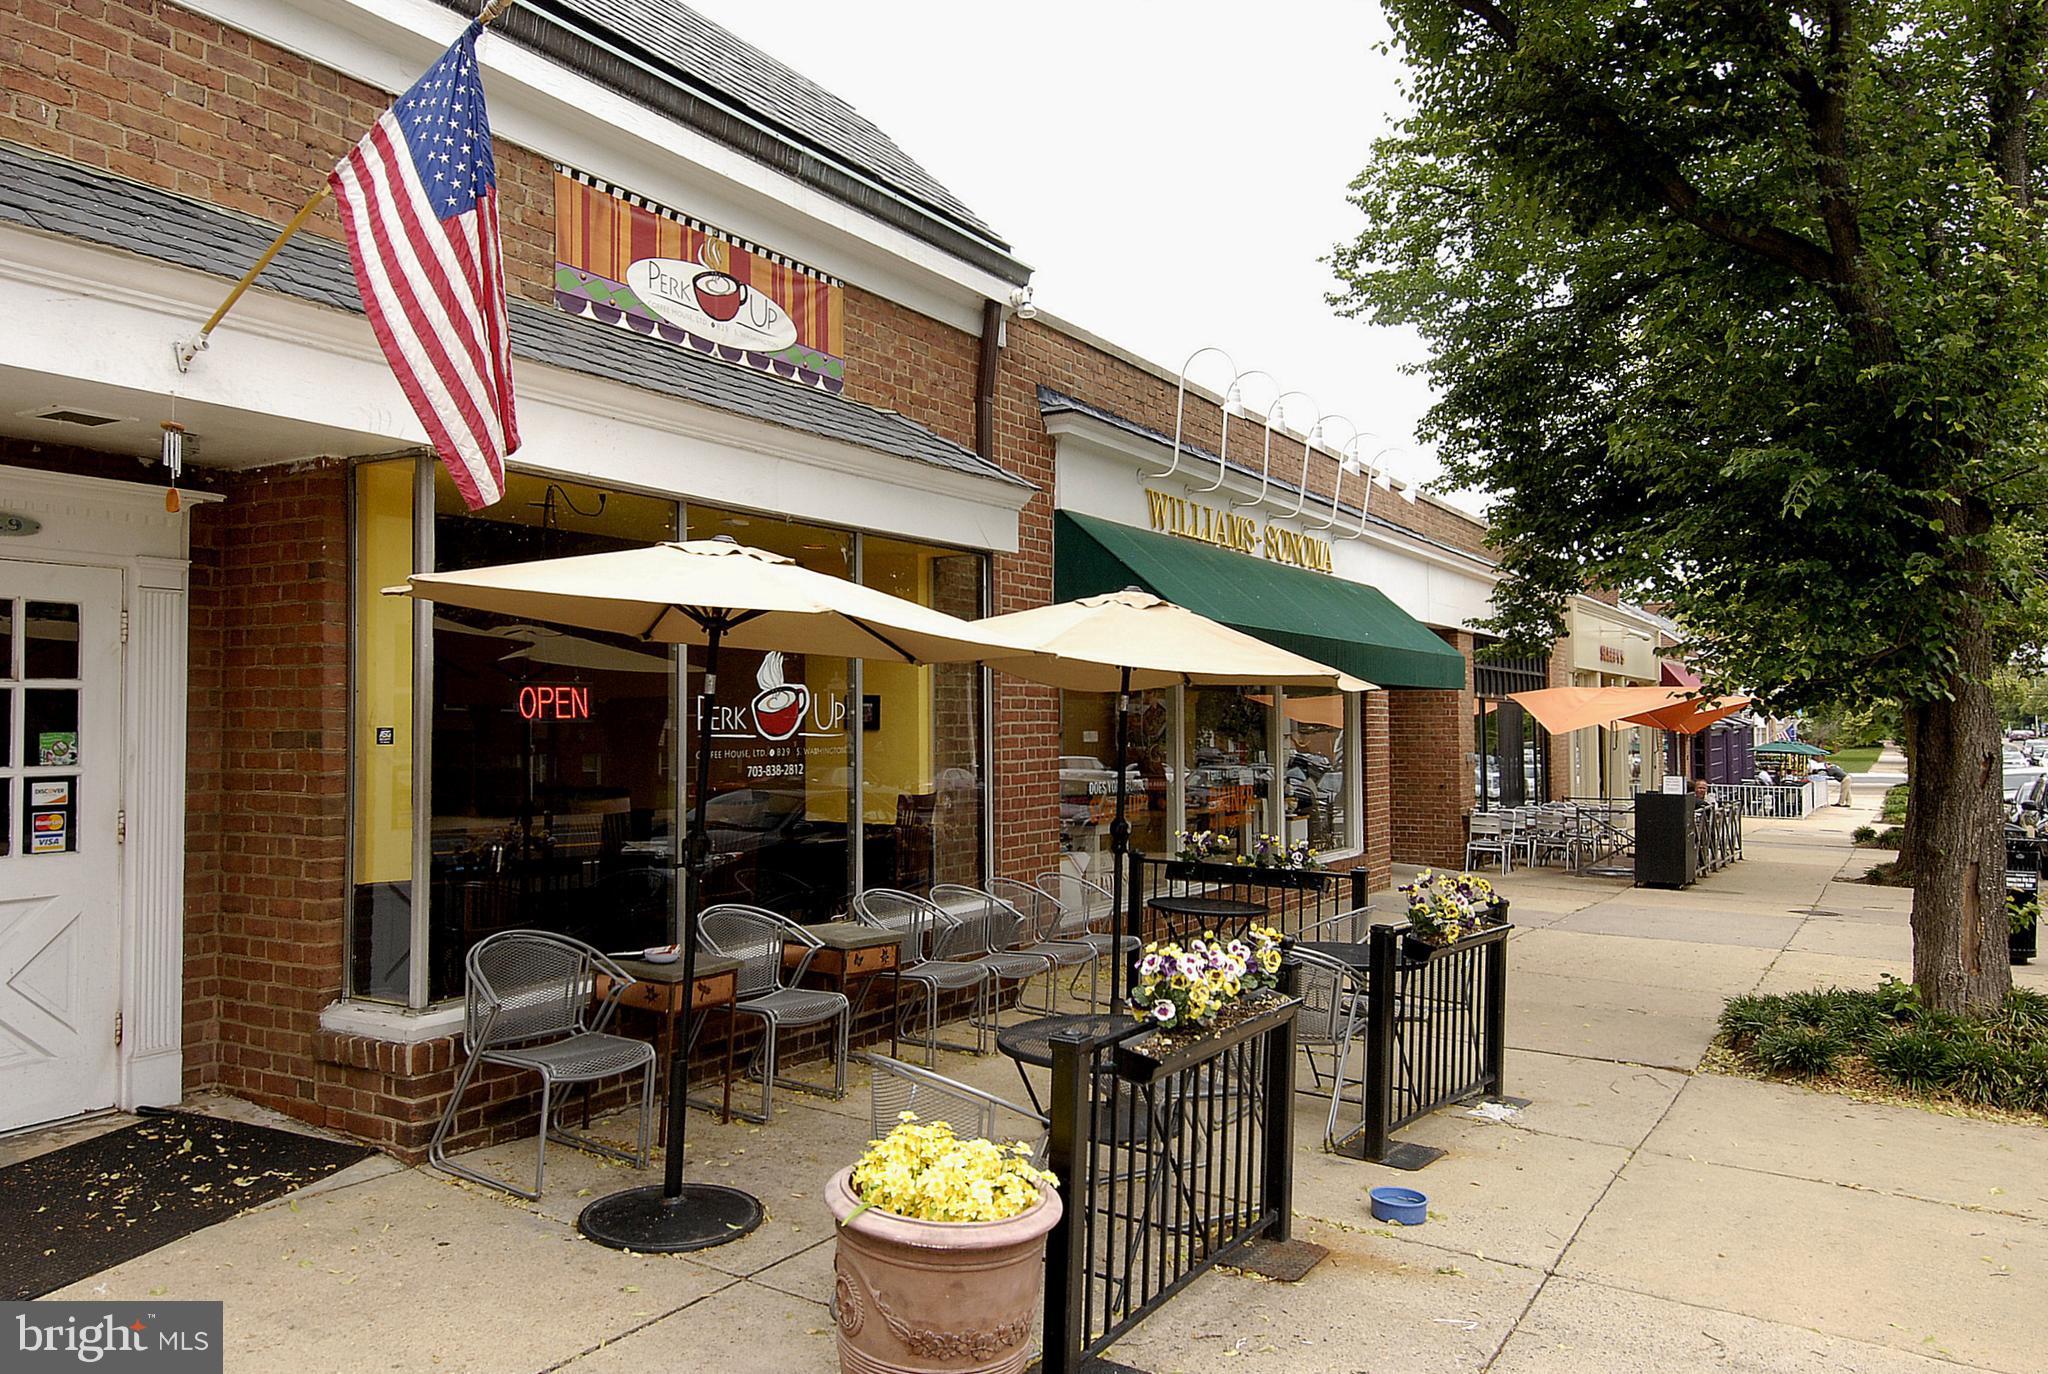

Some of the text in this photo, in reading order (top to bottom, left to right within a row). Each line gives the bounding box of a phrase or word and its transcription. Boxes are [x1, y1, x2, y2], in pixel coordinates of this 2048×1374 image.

[648, 260, 778, 330] PERK UP
[519, 686, 588, 719] OPEN
[814, 693, 846, 731] UP
[695, 750, 722, 760] CFEE
[747, 763, 804, 777] 703-838-2812
